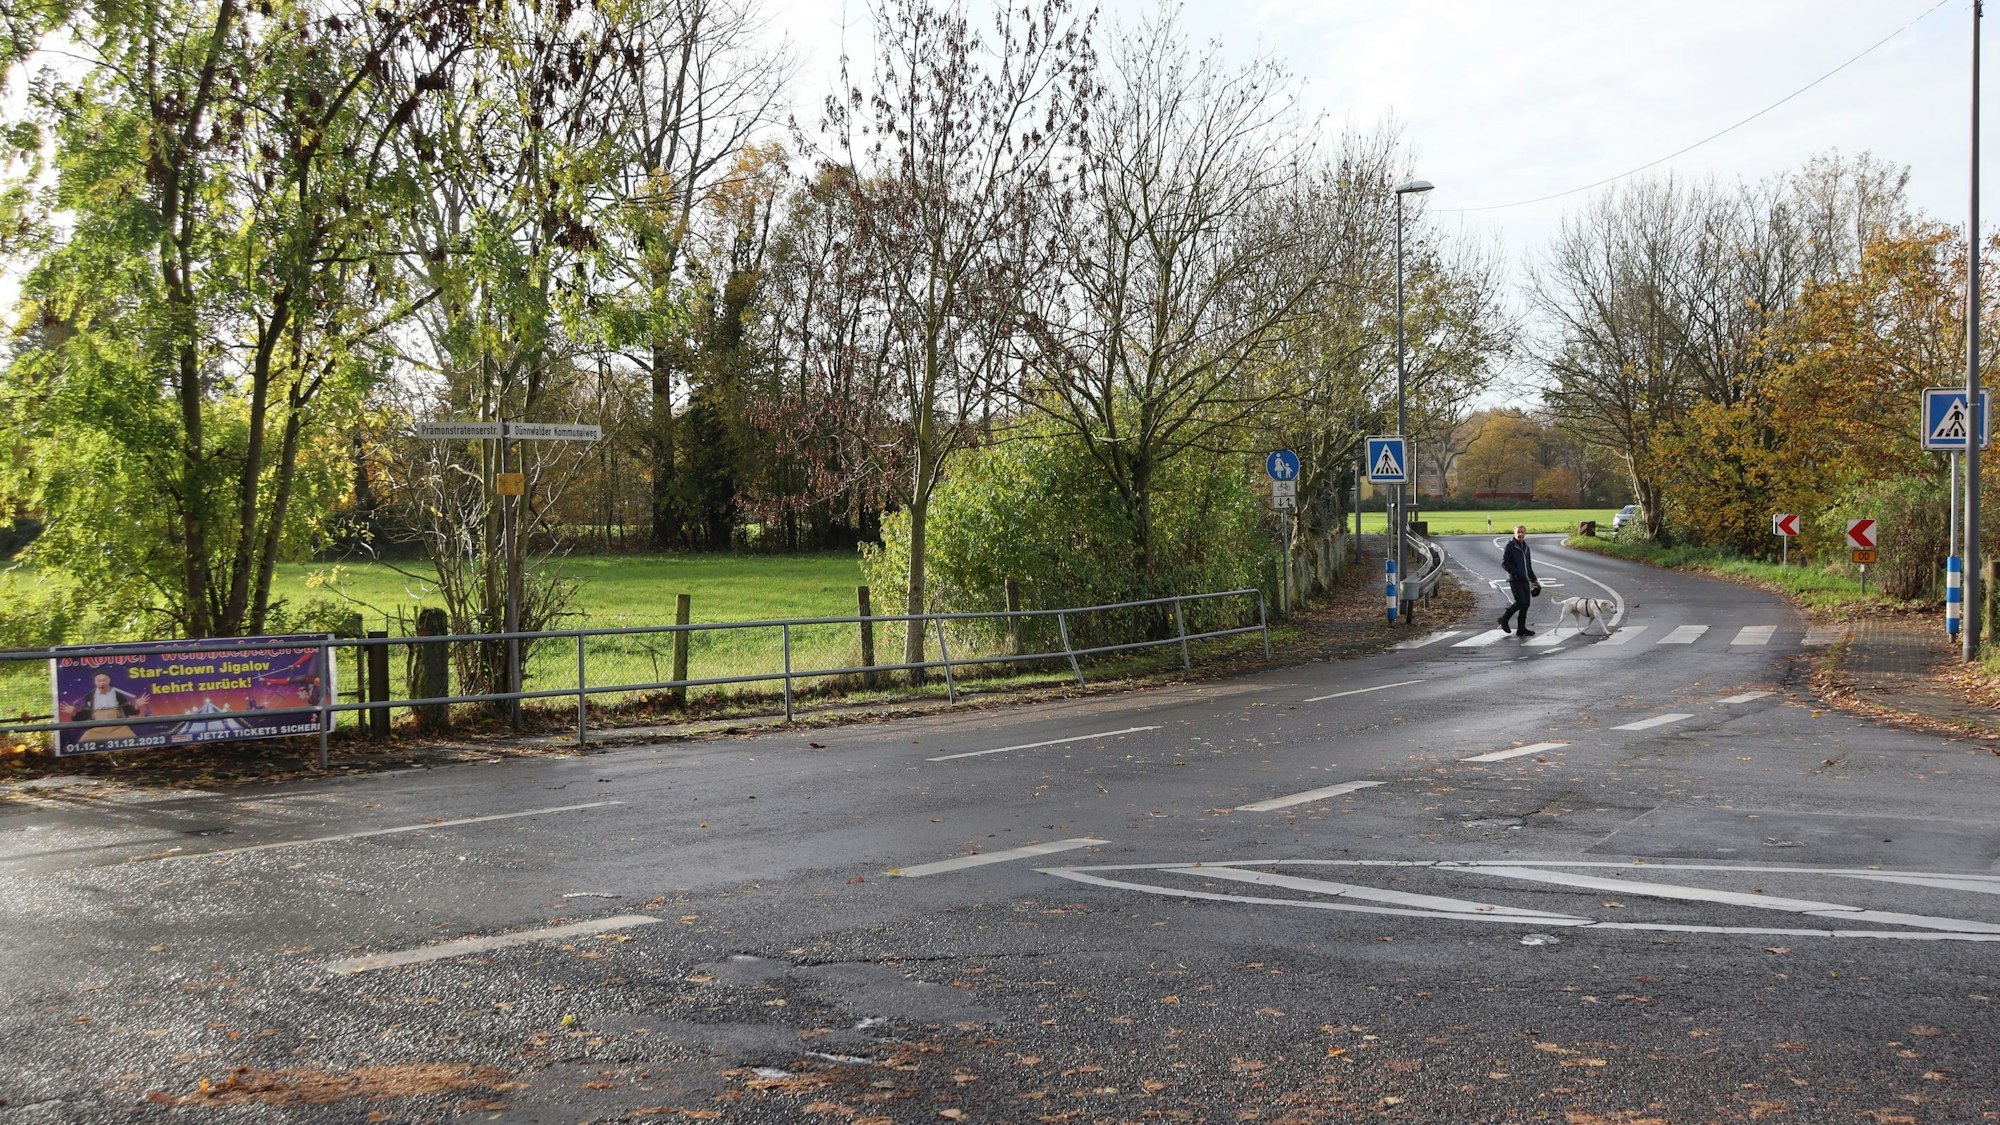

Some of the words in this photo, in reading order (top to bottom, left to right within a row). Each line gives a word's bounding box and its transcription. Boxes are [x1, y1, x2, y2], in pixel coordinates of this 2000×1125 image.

[421, 424, 499, 436] Prämonstratenserstr.
[514, 425, 551, 437] Dünnwalder
[553, 427, 598, 439] Kommunalweg
[129, 664, 214, 679] Star-Clown
[220, 661, 269, 674] Jigalov
[152, 681, 193, 695] kehrt
[198, 678, 252, 691] zurück!
[198, 730, 230, 741] JETZT
[233, 726, 278, 737] TICKETS
[66, 741, 97, 752] 01.12
[106, 735, 166, 750] 31.12.2023
